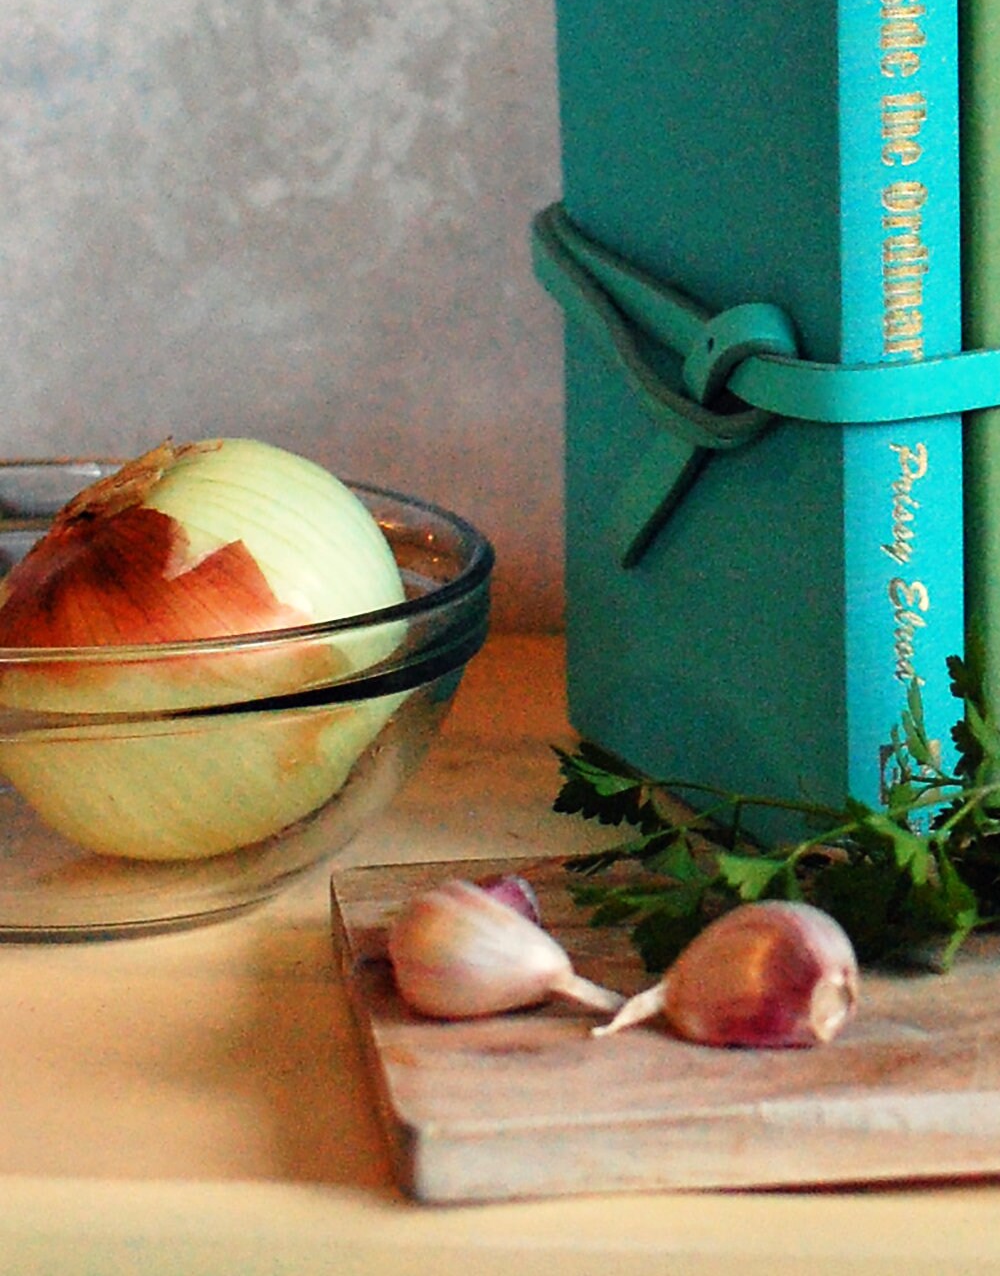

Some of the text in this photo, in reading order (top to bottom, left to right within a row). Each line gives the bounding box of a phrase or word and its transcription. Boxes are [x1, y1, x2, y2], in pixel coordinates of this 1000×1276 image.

[880, 91, 925, 167] the
[881, 181, 929, 364] Ordinar
[882, 443, 930, 685] Prissy Elrod
